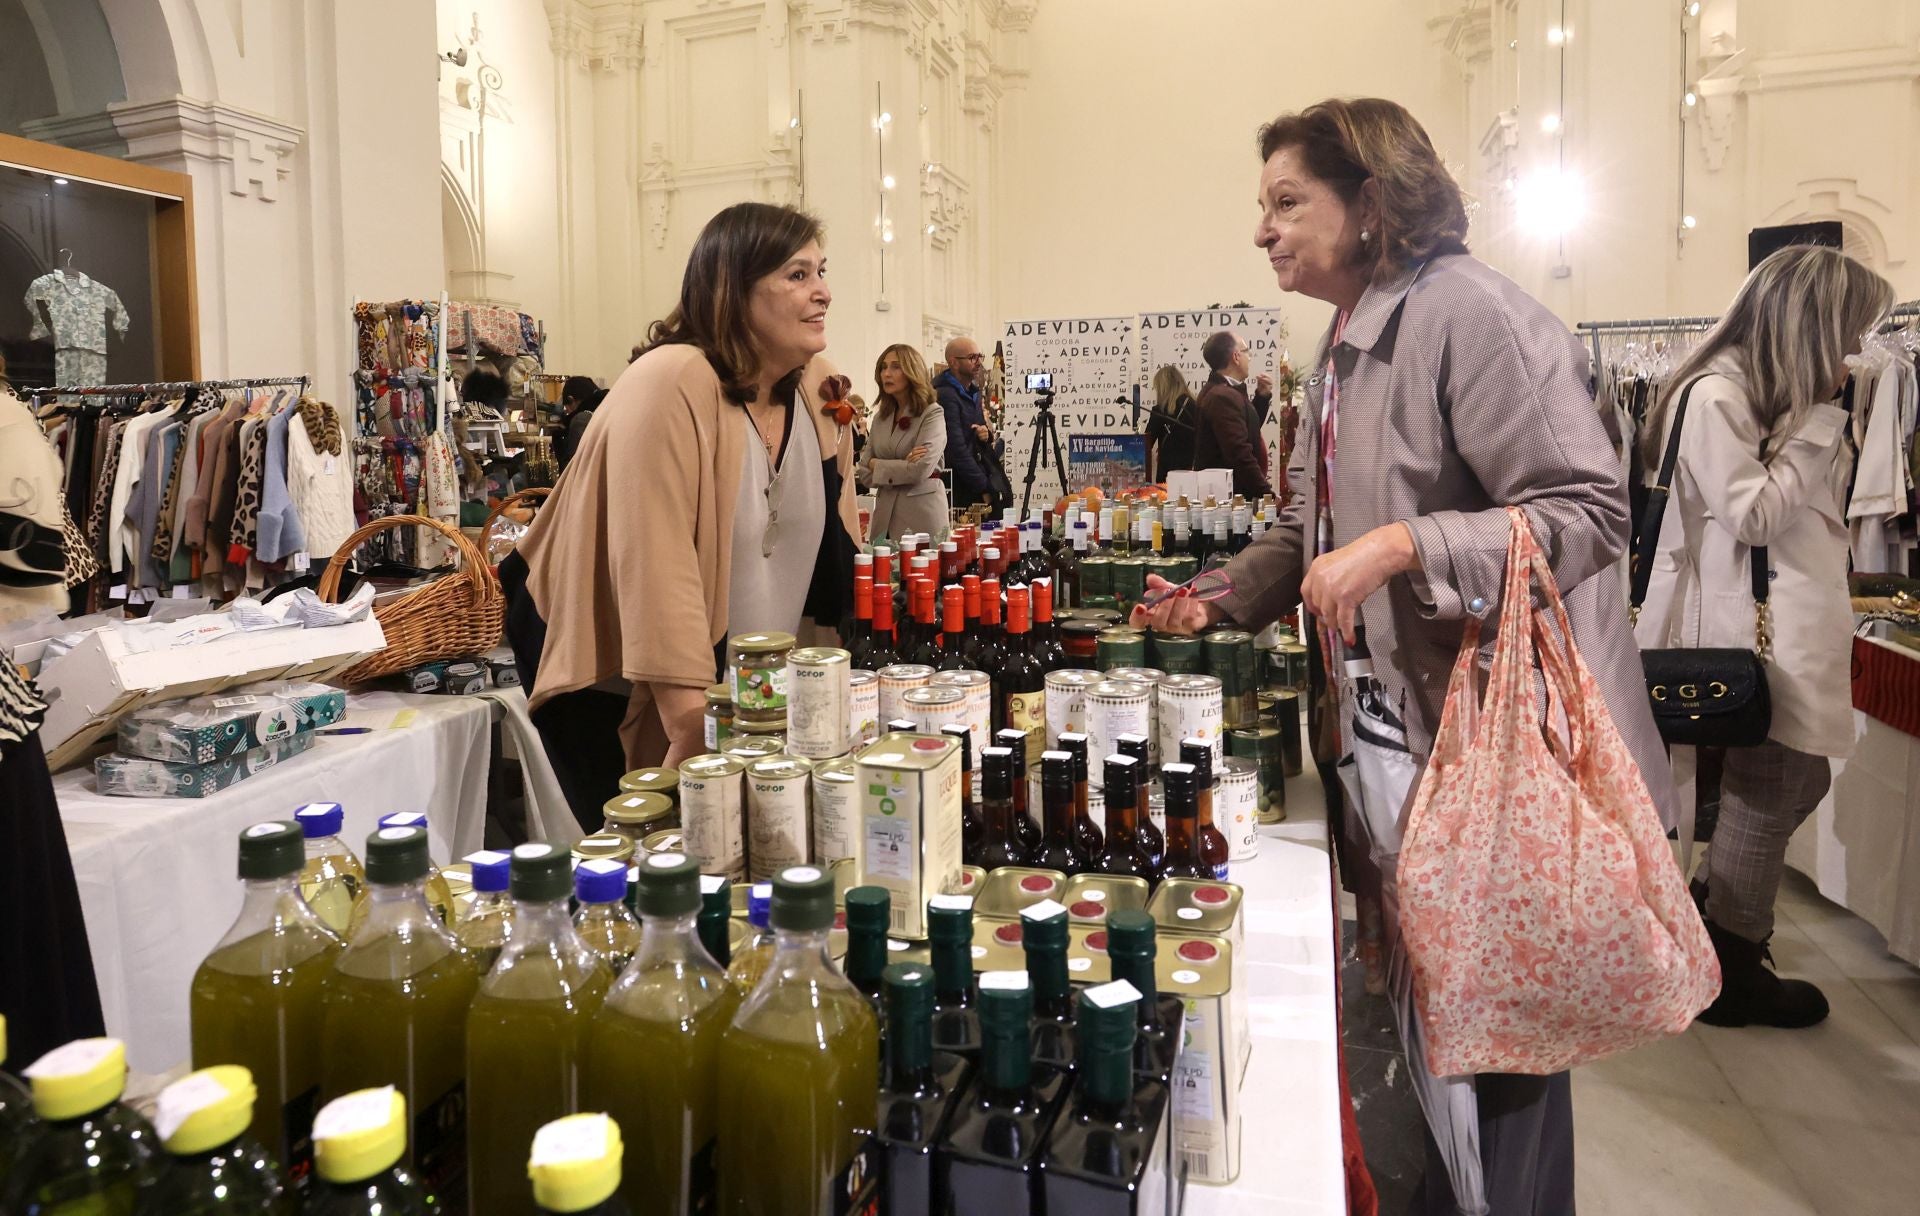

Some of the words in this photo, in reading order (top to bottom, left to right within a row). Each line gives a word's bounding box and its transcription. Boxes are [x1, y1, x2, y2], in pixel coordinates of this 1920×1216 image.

[1141, 312, 1249, 329] ADEVIDA
[1006, 320, 1105, 337] ADEVIDA
[1173, 331, 1214, 339] CÓRDO
[1059, 346, 1131, 358] ADEVIDA
[1005, 342, 1013, 393] ADEVIDA
[1141, 335, 1149, 389] ADEVIDA
[1015, 385, 1078, 395] ADIDA
[1119, 357, 1127, 410] AEVIDA
[1028, 413, 1131, 429] AEVIDA
[1072, 438, 1084, 453] XV
[1084, 437, 1116, 446] Baratillo
[1084, 445, 1095, 453] de
[1095, 445, 1123, 453] Navidad
[1678, 684, 1698, 699] G
